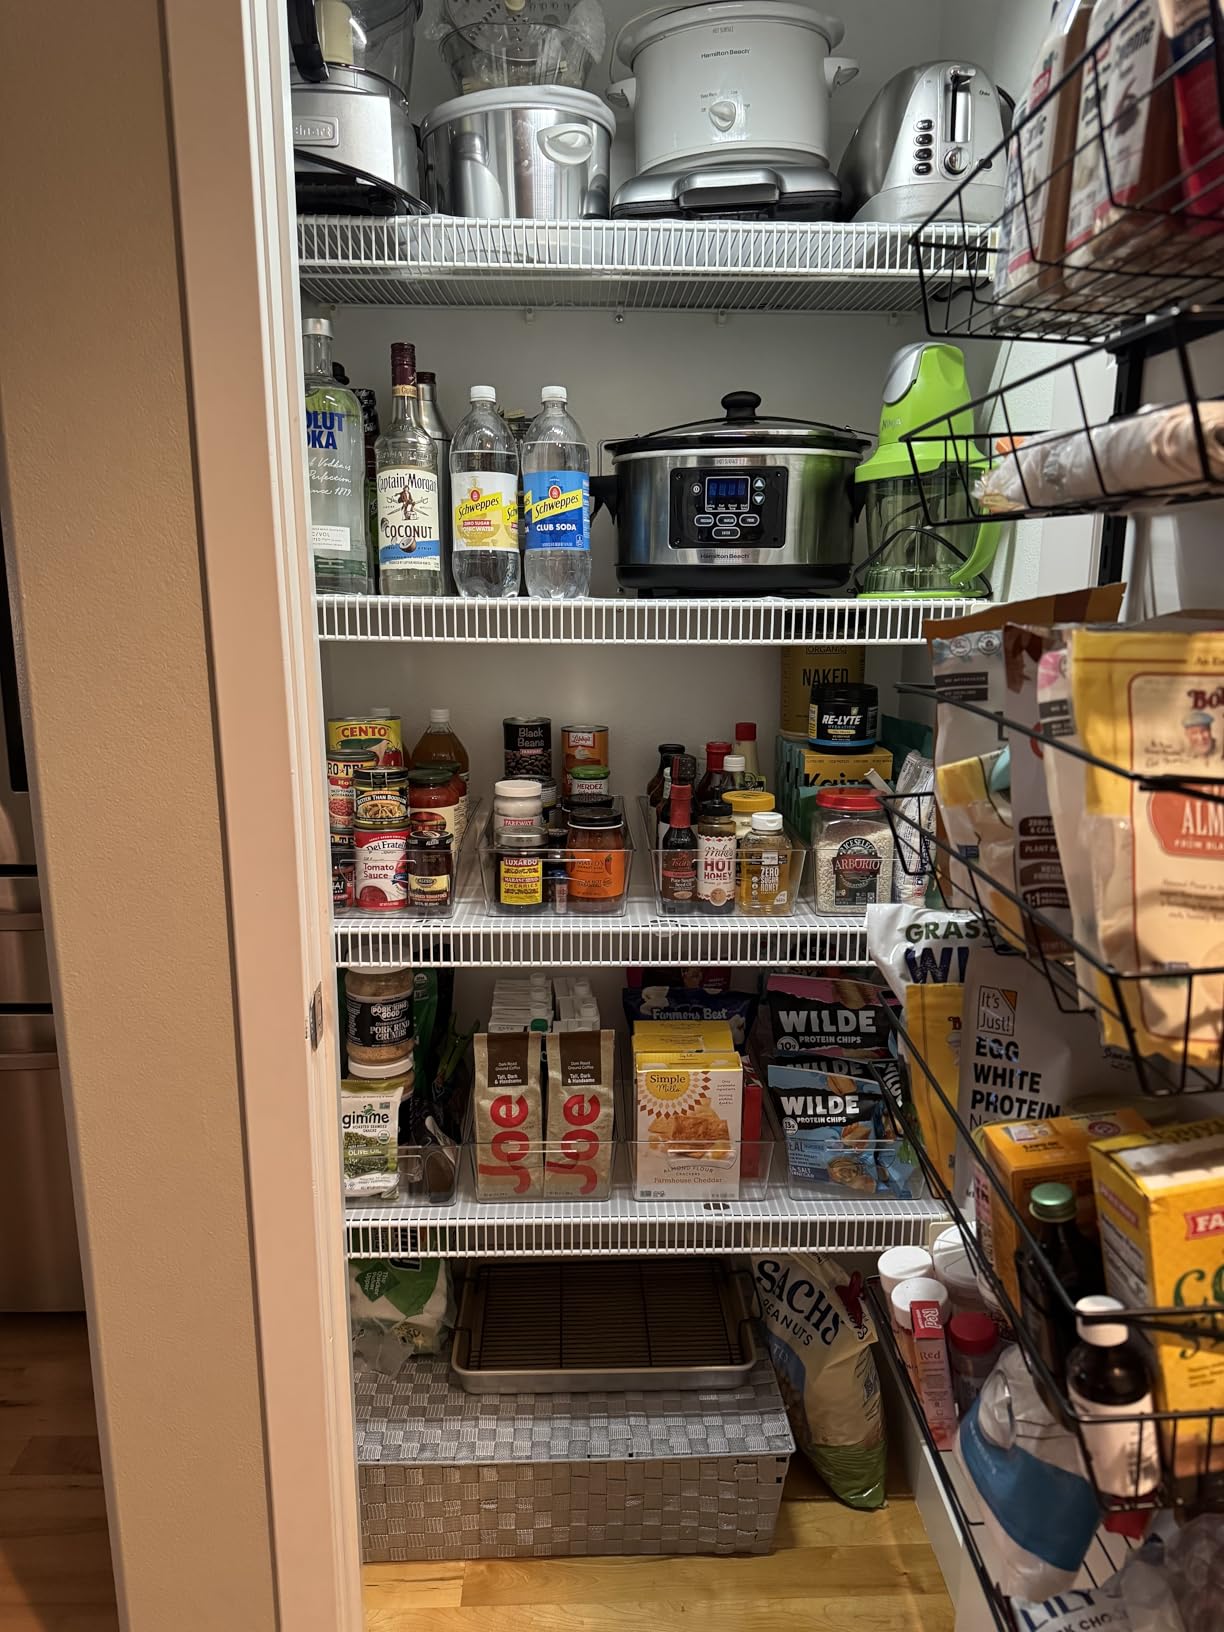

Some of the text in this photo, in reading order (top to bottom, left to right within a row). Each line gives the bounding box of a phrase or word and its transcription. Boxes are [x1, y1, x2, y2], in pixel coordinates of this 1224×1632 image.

[377, 473, 405, 493] Captain
[458, 496, 500, 521] Schweppes
[535, 495, 579, 518] Schweppes
[385, 525, 432, 538] COCONUT
[802, 668, 849, 686] NAKED
[822, 715, 862, 725] RE-LYTE
[341, 725, 387, 738] CENTO
[519, 727, 544, 738] Black
[518, 738, 545, 748] Beans
[372, 793, 385, 801] THAN
[363, 862, 395, 872] Tomato
[506, 858, 538, 866] LUXARDO
[704, 858, 733, 872] HOT
[835, 858, 880, 871] ARBORIO
[363, 870, 389, 879] Sauce
[704, 872, 733, 881] HONEY
[760, 867, 780, 877] ZERO
[760, 876, 779, 884] SUGAR
[760, 883, 778, 892] HONEY
[981, 991, 1001, 1009] It's
[381, 1010, 401, 1019] GOOD
[703, 1007, 728, 1020] Best
[778, 1009, 877, 1033] WILDE
[979, 1012, 1012, 1032] Just!
[370, 1025, 393, 1034] PORK
[799, 1035, 862, 1044] PROTEIN CHIPS
[975, 1036, 1020, 1063] EGG
[649, 1074, 686, 1084] Simple
[973, 1062, 1042, 1095] WHITE
[656, 1083, 681, 1093] Mills
[780, 1095, 860, 1116] WILDE
[970, 1089, 1061, 1120] PROTEIN
[341, 1110, 390, 1130] gimme
[796, 1116, 826, 1124] PROTEIN
[921, 1307, 943, 1330] Red
[920, 1350, 941, 1361] Red
